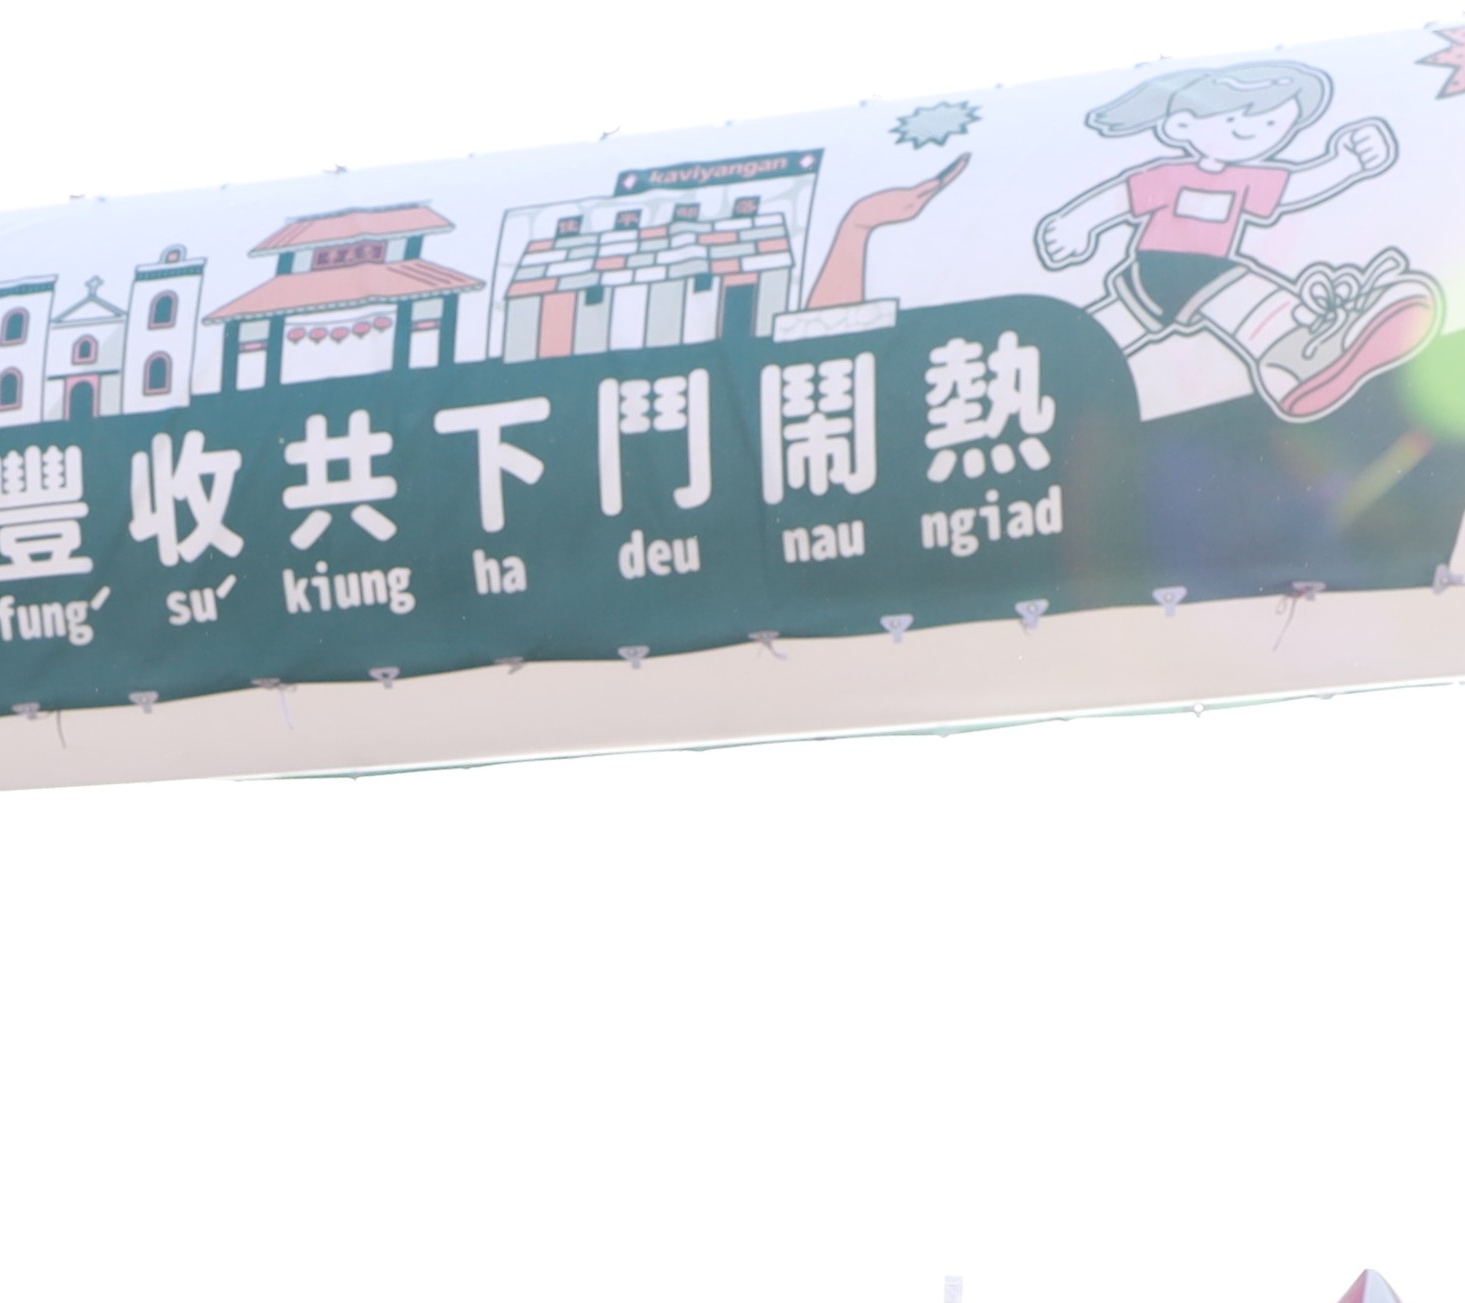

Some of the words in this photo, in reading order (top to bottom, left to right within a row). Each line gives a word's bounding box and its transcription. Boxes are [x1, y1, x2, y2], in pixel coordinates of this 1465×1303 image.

[283, 561, 416, 614] kiung
[474, 550, 527, 594] ha
[619, 531, 700, 579] deu
[783, 522, 866, 563] nau
[921, 486, 1063, 557] ngiad
